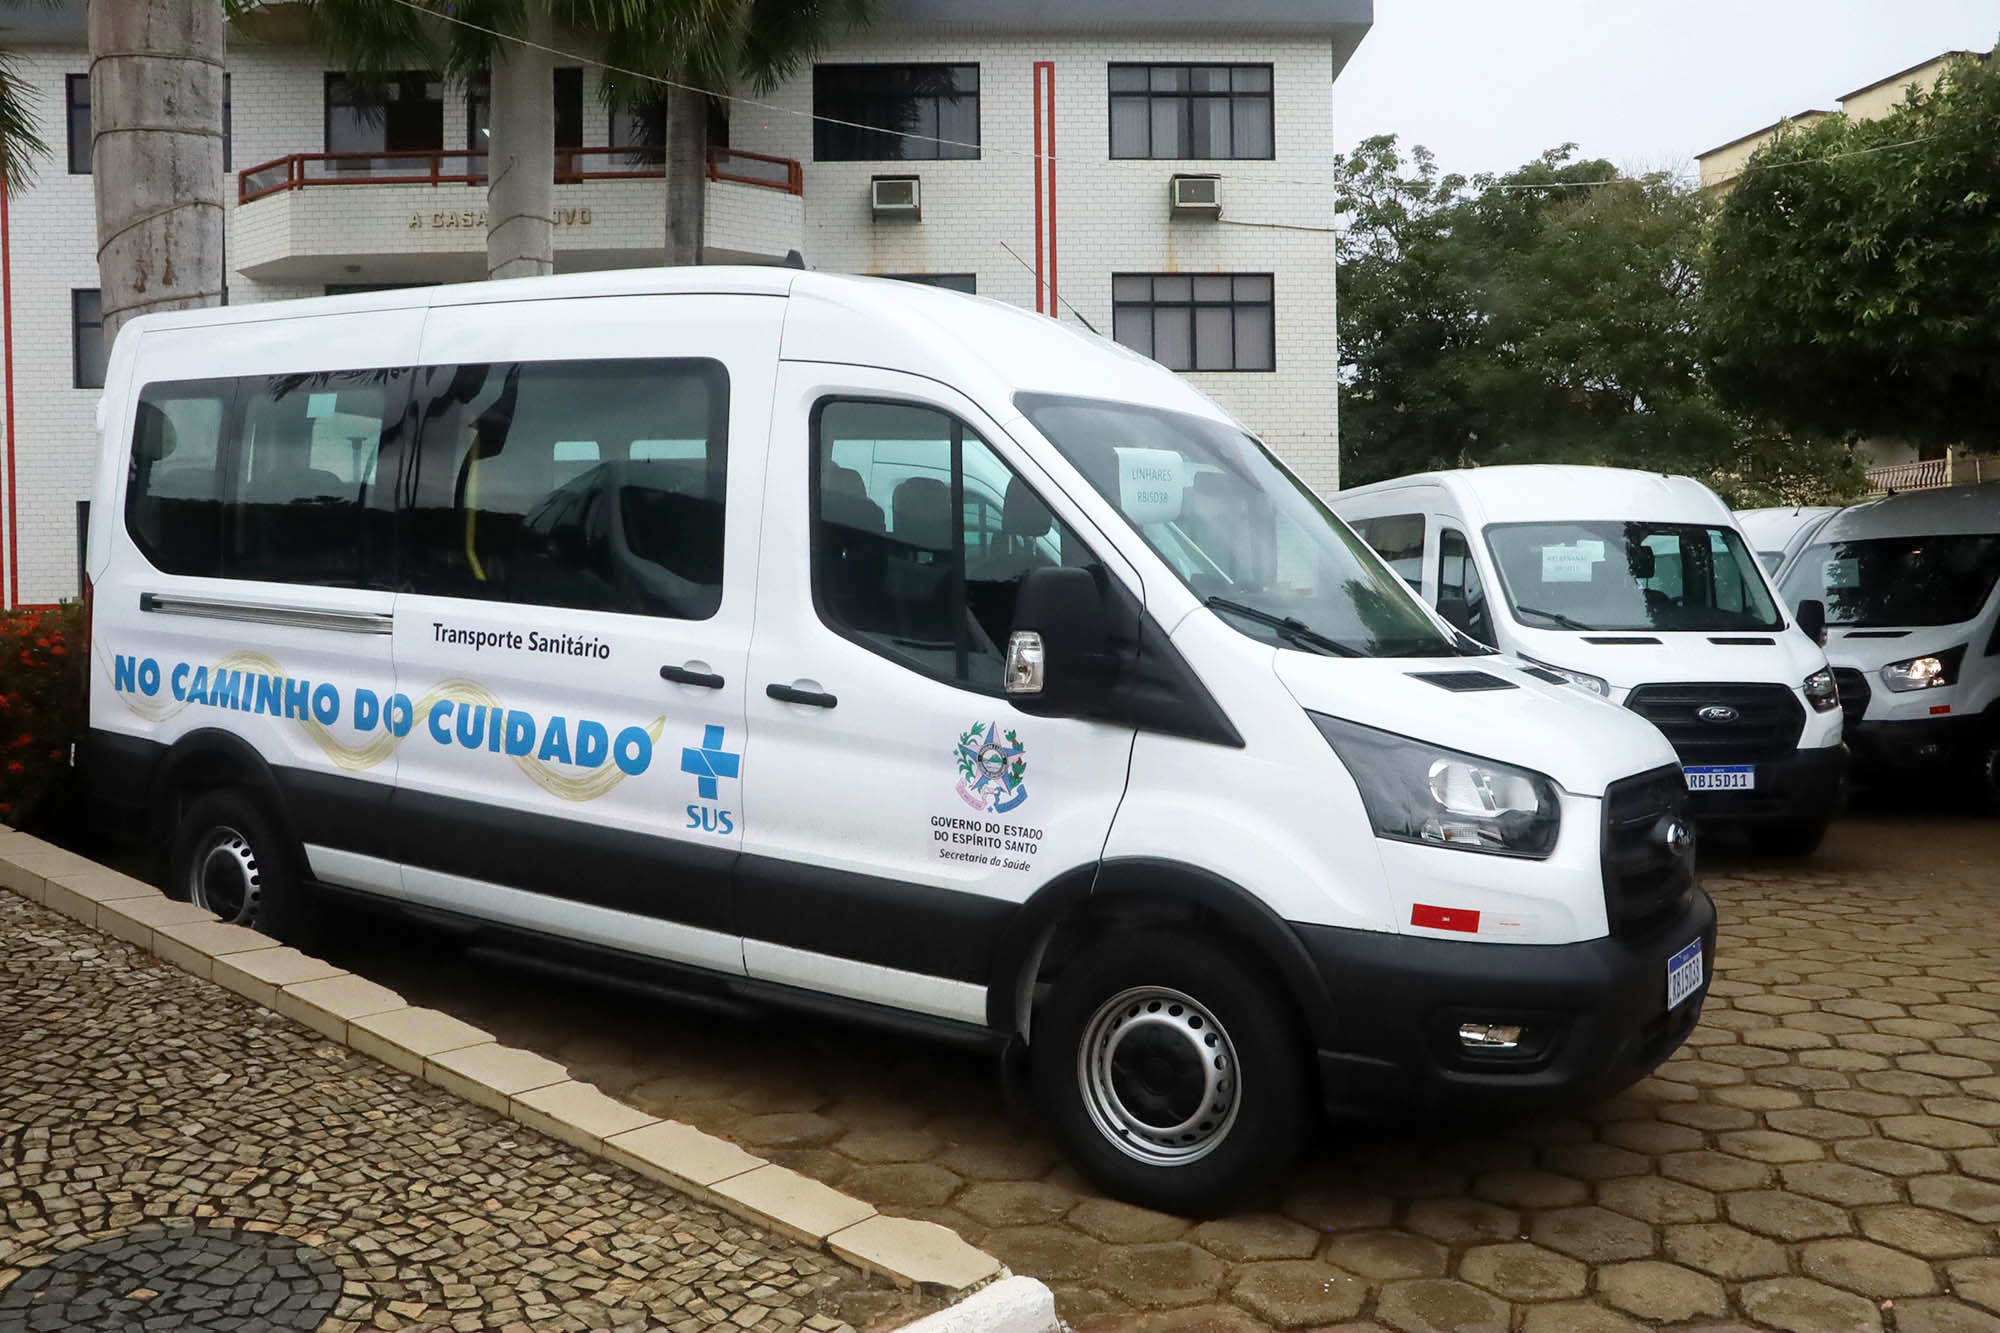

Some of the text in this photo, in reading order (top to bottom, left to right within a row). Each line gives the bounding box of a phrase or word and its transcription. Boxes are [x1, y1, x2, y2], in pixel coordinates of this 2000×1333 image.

[409, 210, 422, 228] A
[431, 207, 489, 229] CASA
[1131, 466, 1172, 481] LINHARES
[433, 622, 610, 659] Transporte Sanitário
[115, 654, 652, 776] NO CAMINHO DO CUIDADO
[1690, 774, 1747, 788] RBI5D11
[686, 804, 733, 835] SUS
[931, 815, 1043, 841] GOVERNO DO ESTADO
[934, 830, 1038, 855] DO ESPÍRITO SANTO
[939, 848, 1031, 872] Secretaria da Saúde
